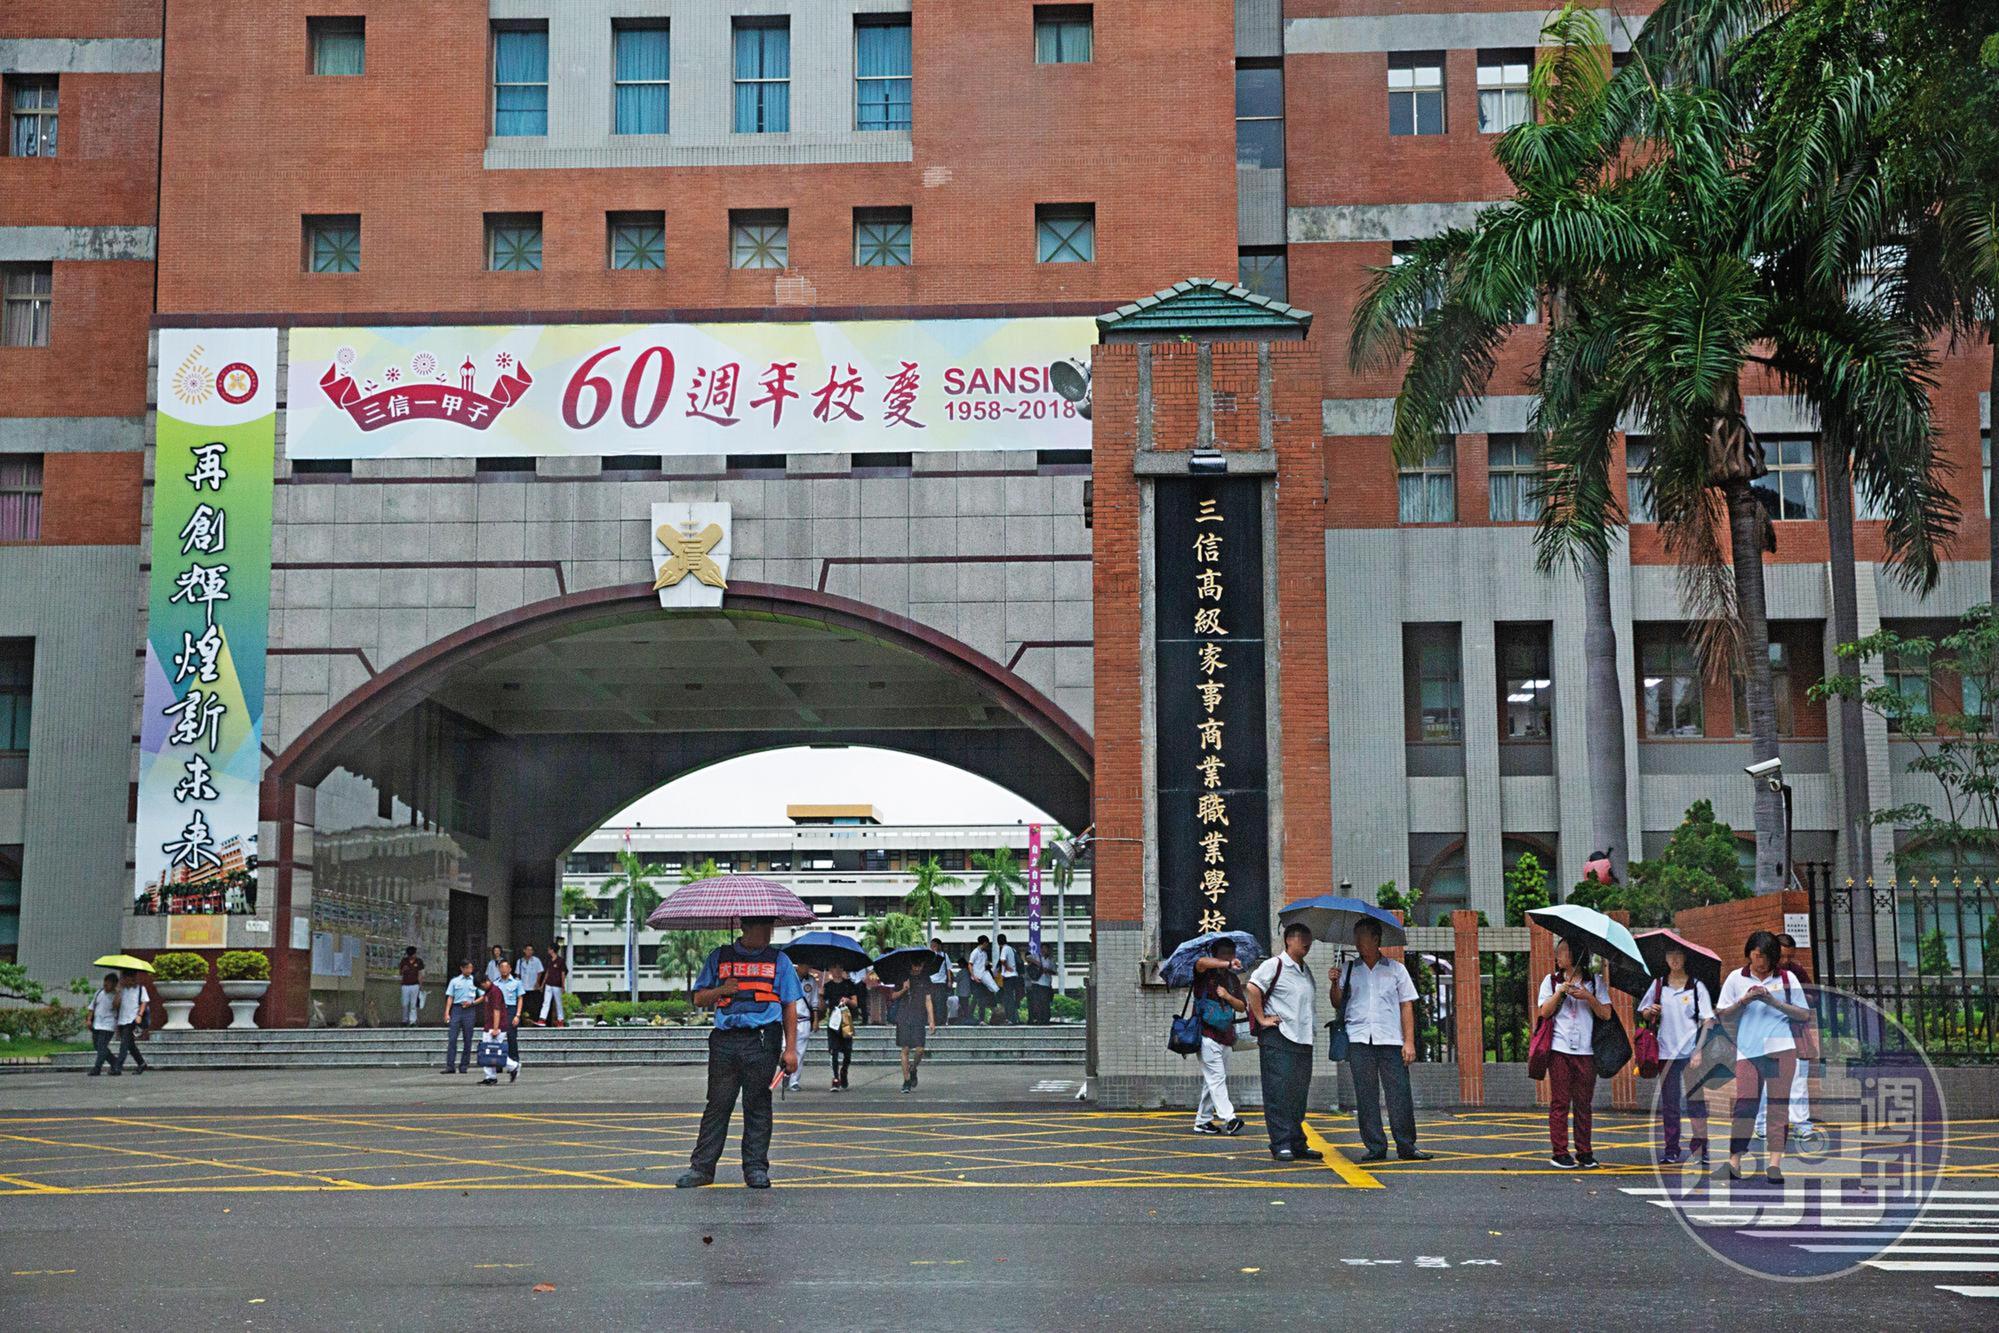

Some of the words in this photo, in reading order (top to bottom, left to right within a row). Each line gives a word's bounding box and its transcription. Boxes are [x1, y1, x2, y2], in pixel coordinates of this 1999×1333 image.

[561, 345, 927, 430] 60週年校慶
[943, 366, 1059, 395] SANSI
[363, 394, 489, 424] 三信一甲子
[944, 399, 1076, 421] 1958~2018
[1192, 498, 1229, 933] 三信高級家事商業職業學校
